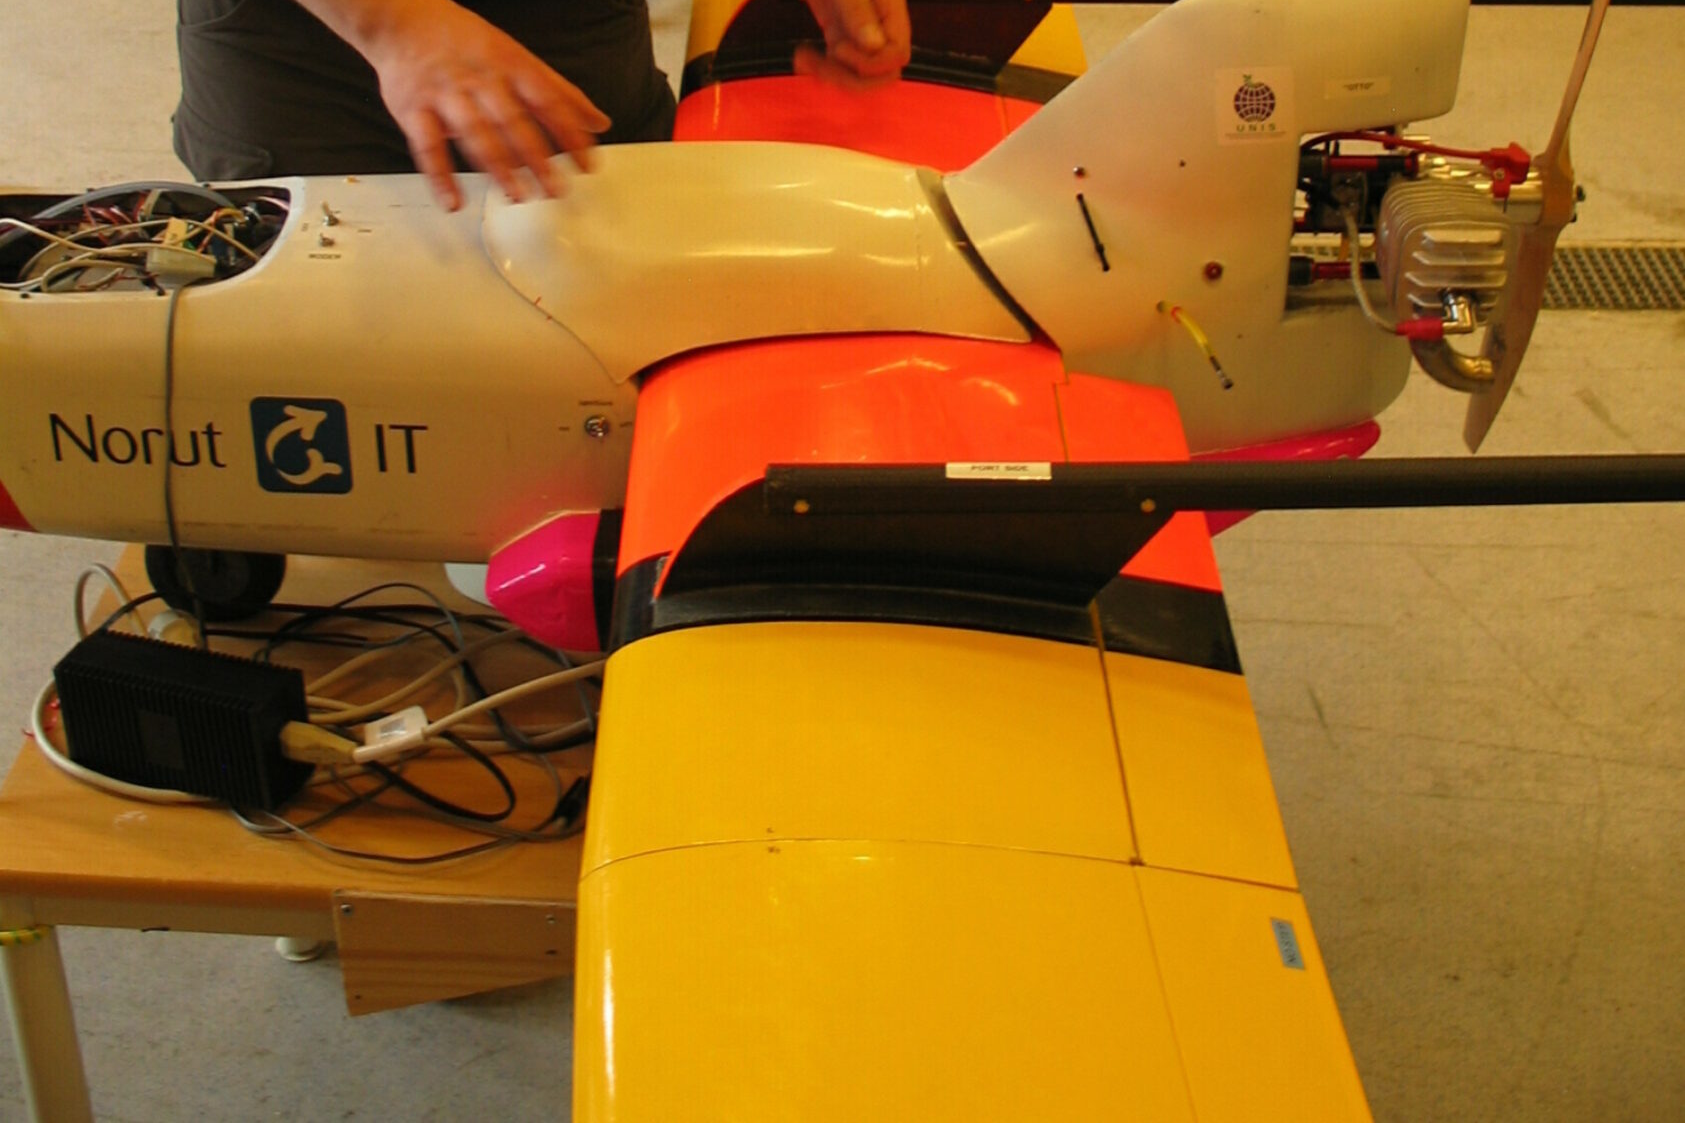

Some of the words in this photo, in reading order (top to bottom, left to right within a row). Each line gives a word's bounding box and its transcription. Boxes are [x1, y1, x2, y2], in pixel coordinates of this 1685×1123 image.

[1236, 123, 1276, 133] UNIS
[48, 413, 227, 468] Norut
[375, 424, 428, 473] IT
